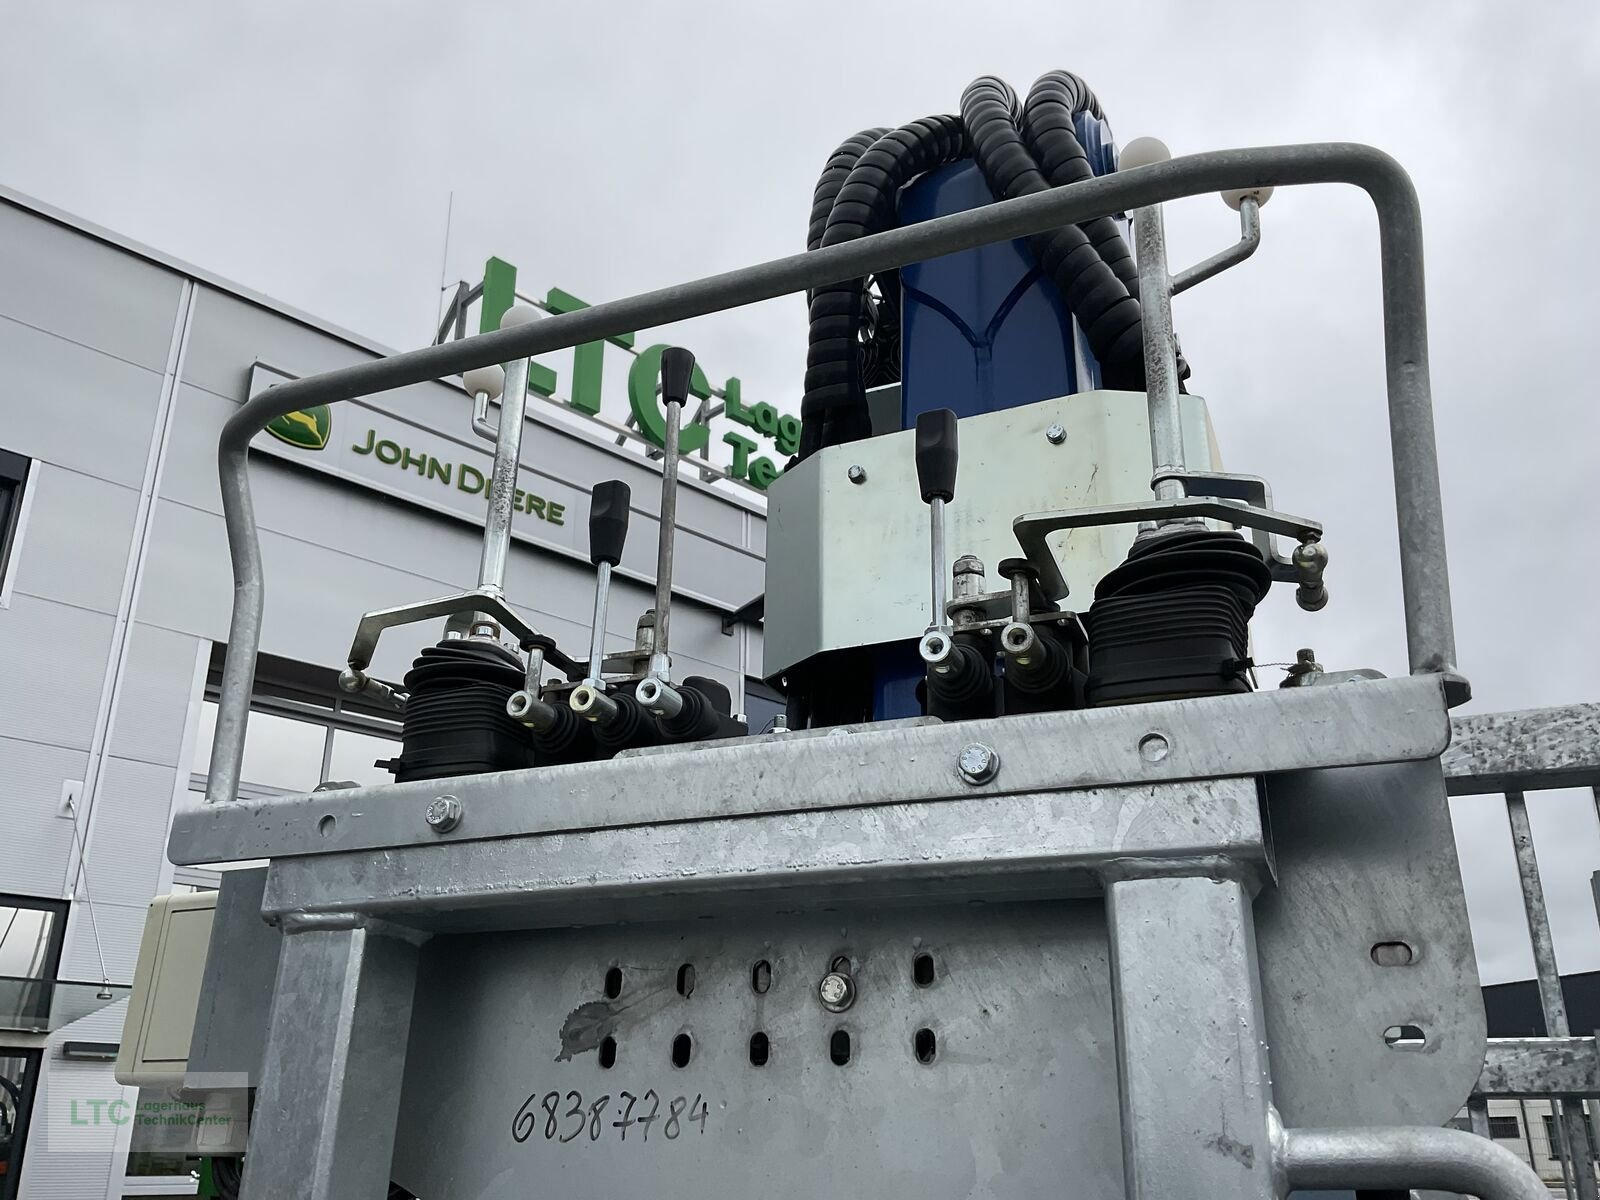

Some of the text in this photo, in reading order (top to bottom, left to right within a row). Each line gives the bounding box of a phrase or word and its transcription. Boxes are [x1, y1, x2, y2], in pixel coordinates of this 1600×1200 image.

[479, 256, 712, 456] LTC
[352, 429, 452, 485] JOHN
[723, 431, 785, 490] Te
[511, 1089, 709, 1143] 68387784
